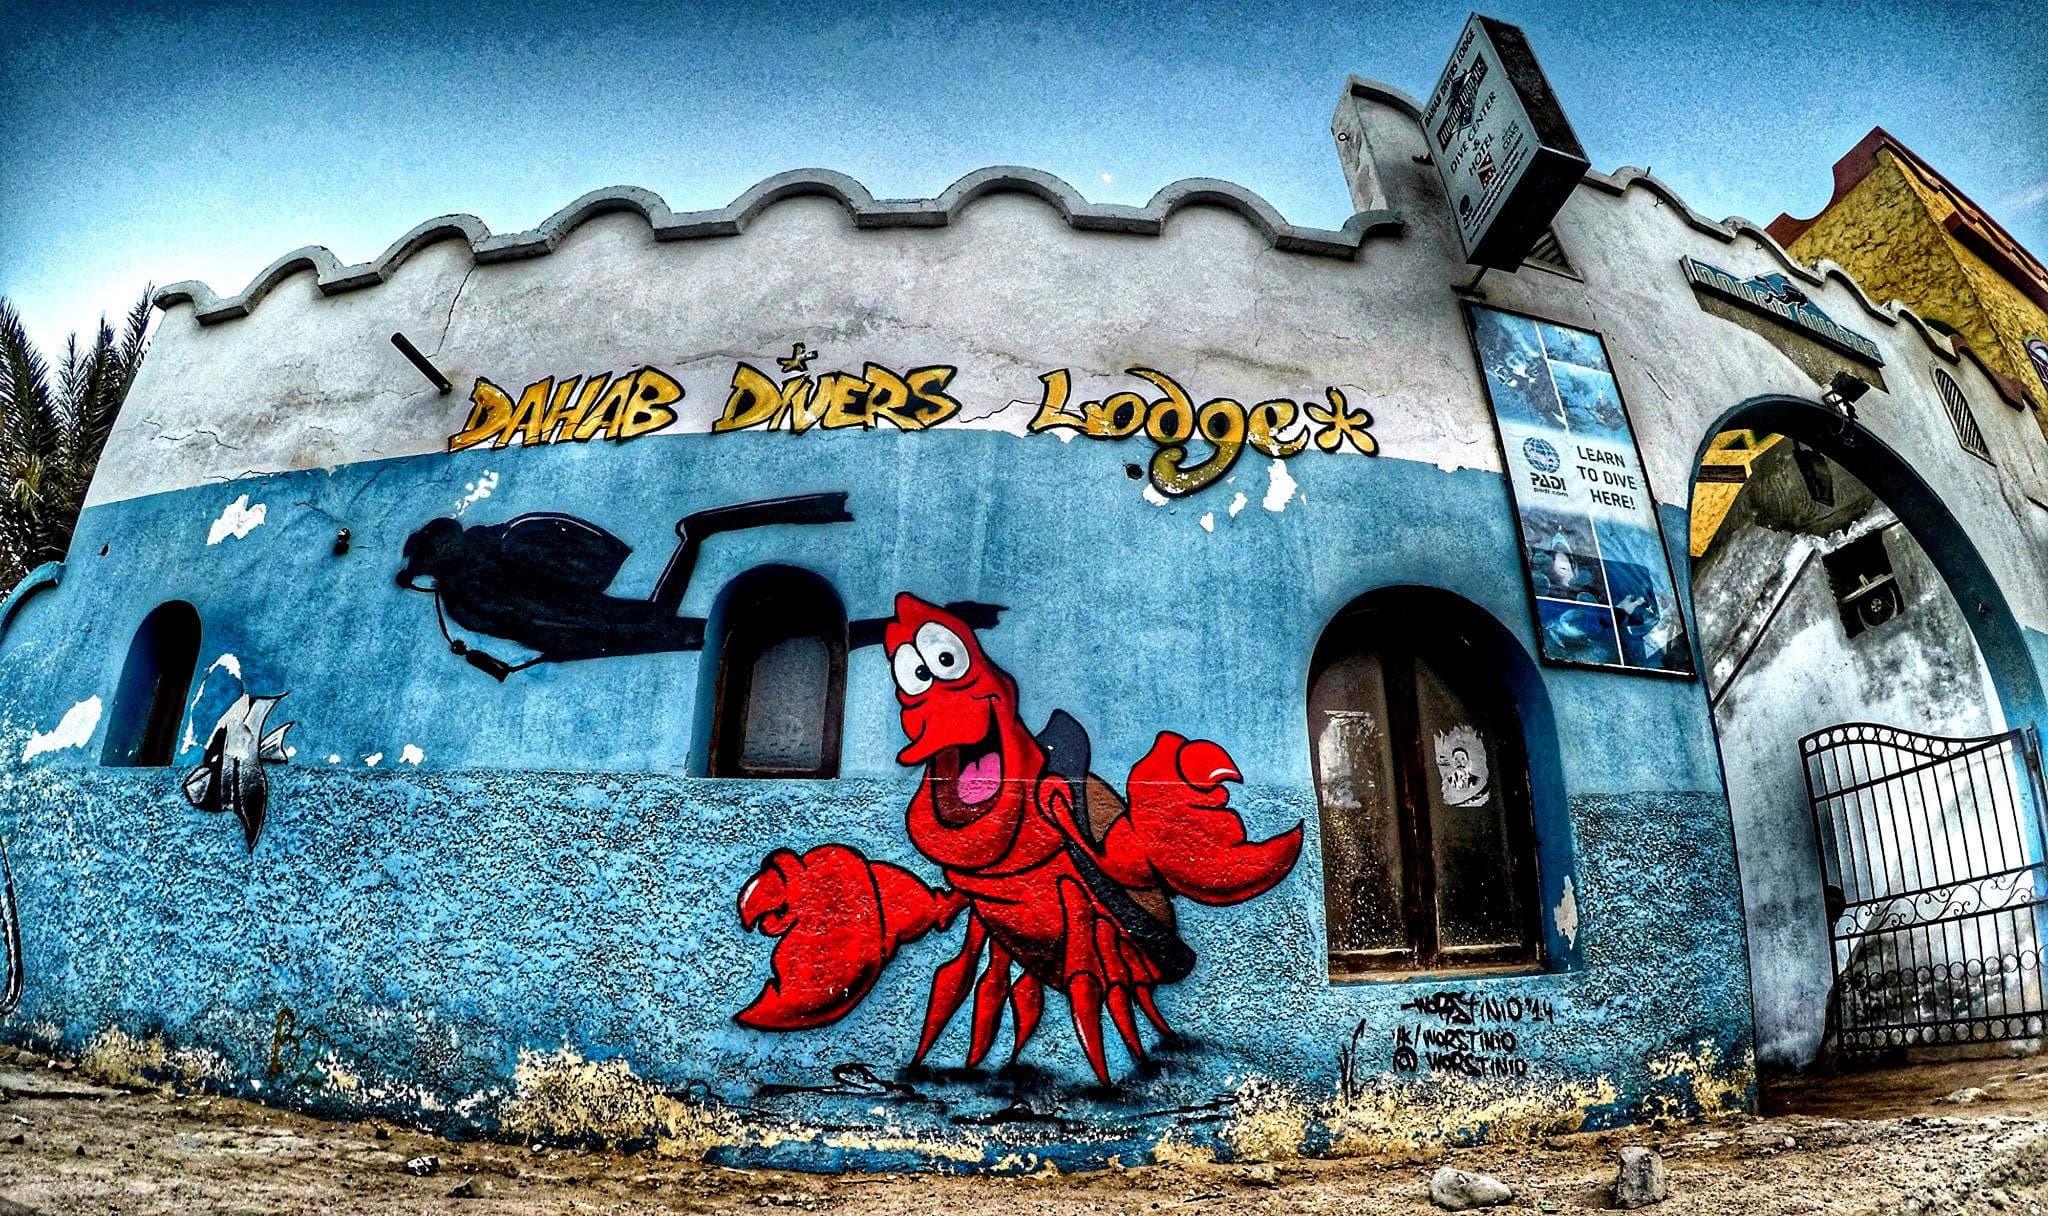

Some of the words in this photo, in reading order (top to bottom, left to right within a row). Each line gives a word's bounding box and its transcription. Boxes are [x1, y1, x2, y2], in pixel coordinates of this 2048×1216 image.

[1424, 91, 1442, 128] DAHAB
[1439, 59, 1458, 97] DIVERS
[1456, 26, 1475, 64] LODGE
[1450, 139, 1468, 174] DIVE
[1466, 89, 1496, 143] CENTER
[1468, 130, 1494, 176] HOTEL
[1471, 136, 1480, 153] &
[448, 365, 685, 453] DAHAB
[711, 343, 962, 435] DIVERS
[1577, 445, 1625, 468] LEARN
[1530, 471, 1566, 491] PADI
[1576, 465, 1598, 482] TO
[1603, 470, 1637, 490] DIVE
[1533, 488, 1568, 497] padi.com
[1590, 488, 1635, 510] HERE!
